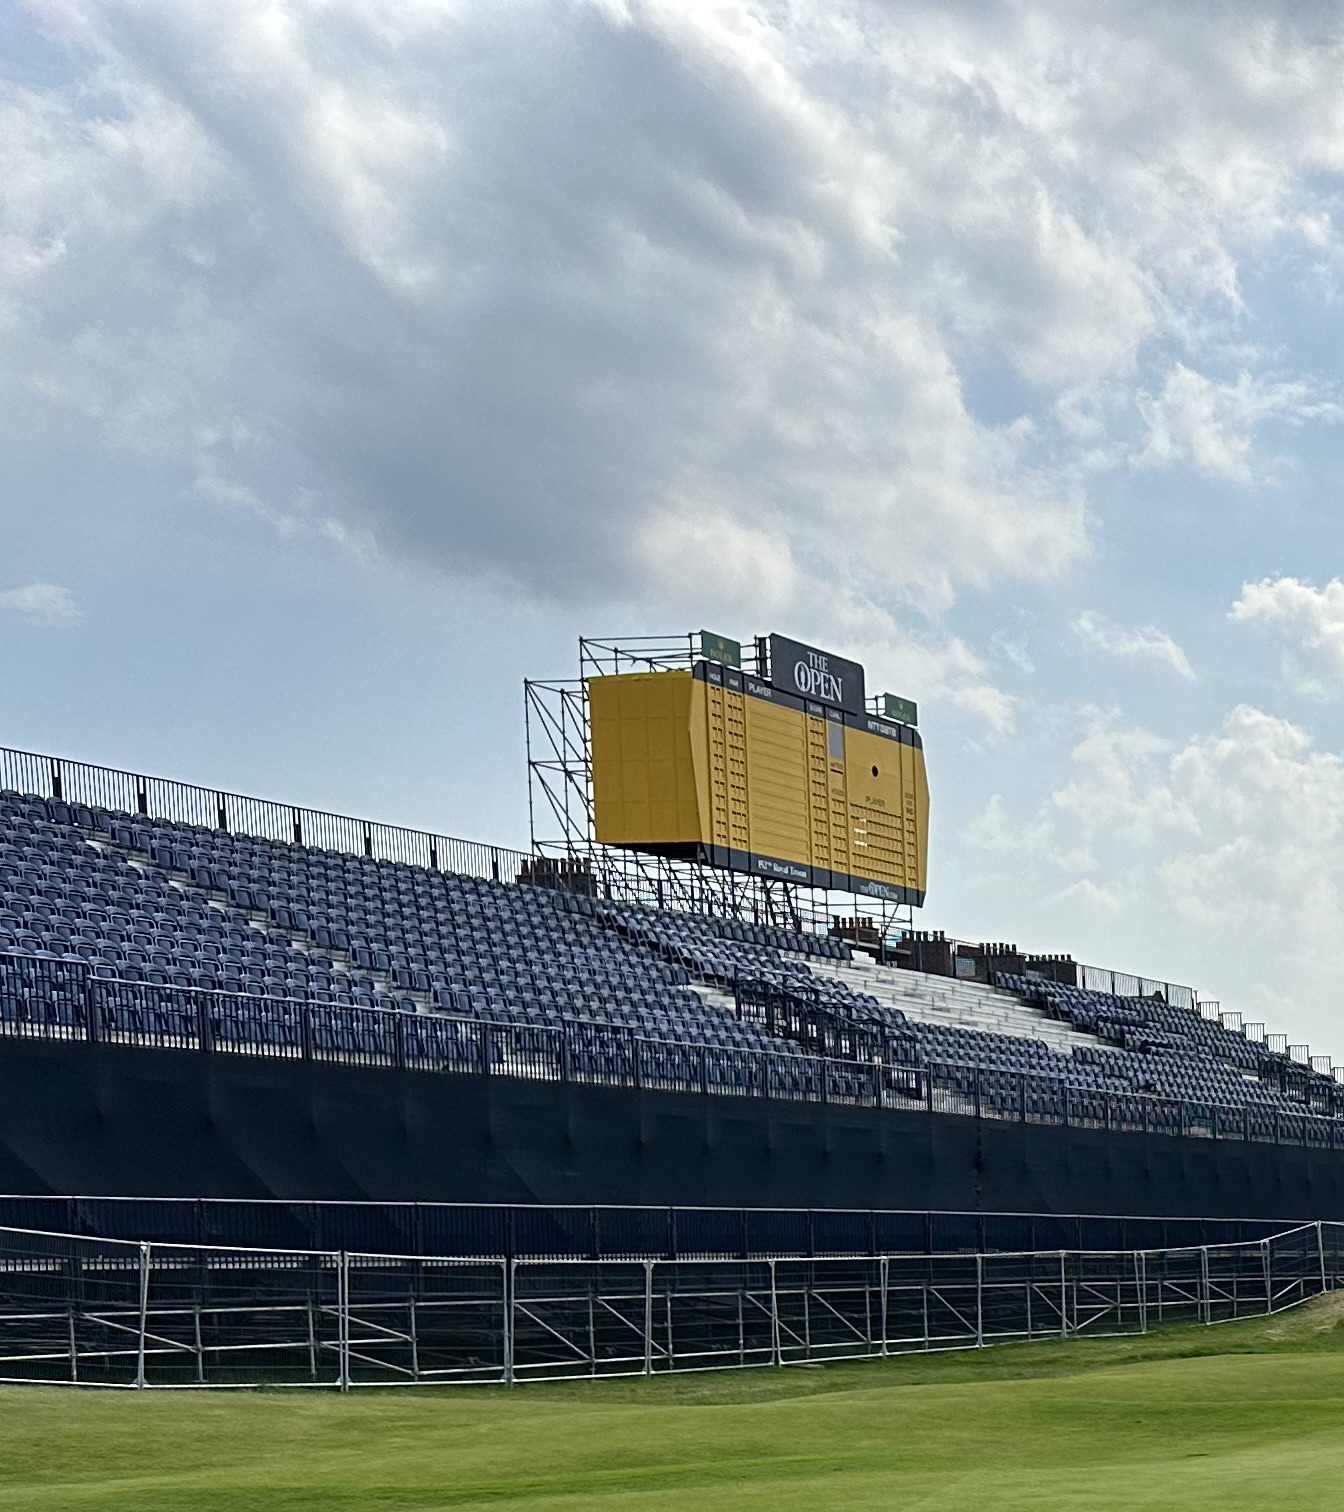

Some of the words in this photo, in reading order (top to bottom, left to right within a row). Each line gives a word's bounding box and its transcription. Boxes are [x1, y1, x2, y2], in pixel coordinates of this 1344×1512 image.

[807, 651, 829, 672] THE
[748, 682, 772, 697] PLAYER
[794, 661, 843, 703] OPEN
